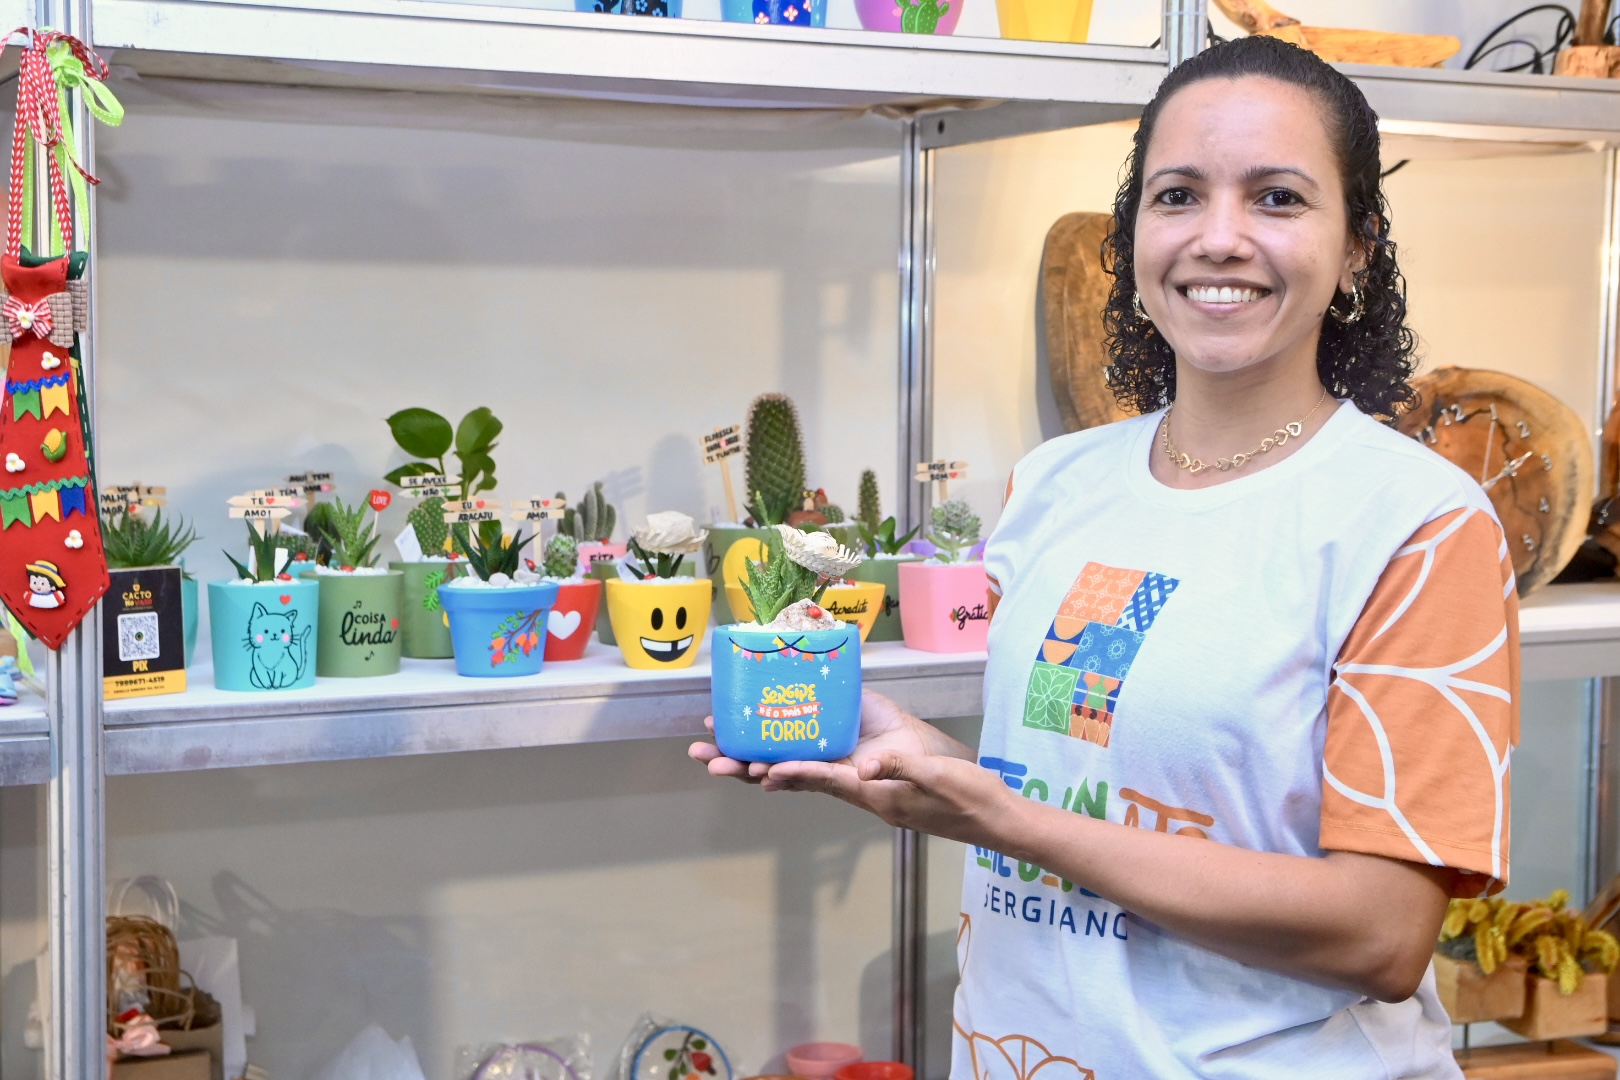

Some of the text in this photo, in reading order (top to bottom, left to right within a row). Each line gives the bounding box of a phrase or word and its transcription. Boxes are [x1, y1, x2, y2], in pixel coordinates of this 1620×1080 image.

[1517, 420, 1530, 439] 2
[1540, 454, 1552, 471] 3
[408, 475, 419, 486] SE
[422, 487, 440, 497] NÃO
[250, 497, 264, 505] TE
[372, 494, 388, 506] LOVE
[461, 501, 473, 510] EU
[530, 500, 542, 509] TE
[1539, 497, 1550, 513] 4
[458, 511, 493, 522] ARACAJU
[1522, 533, 1535, 551] 5
[122, 590, 152, 600] CACTO
[339, 611, 397, 646] linda
[132, 659, 149, 672] PIX
[761, 713, 820, 742] FORRÓ
